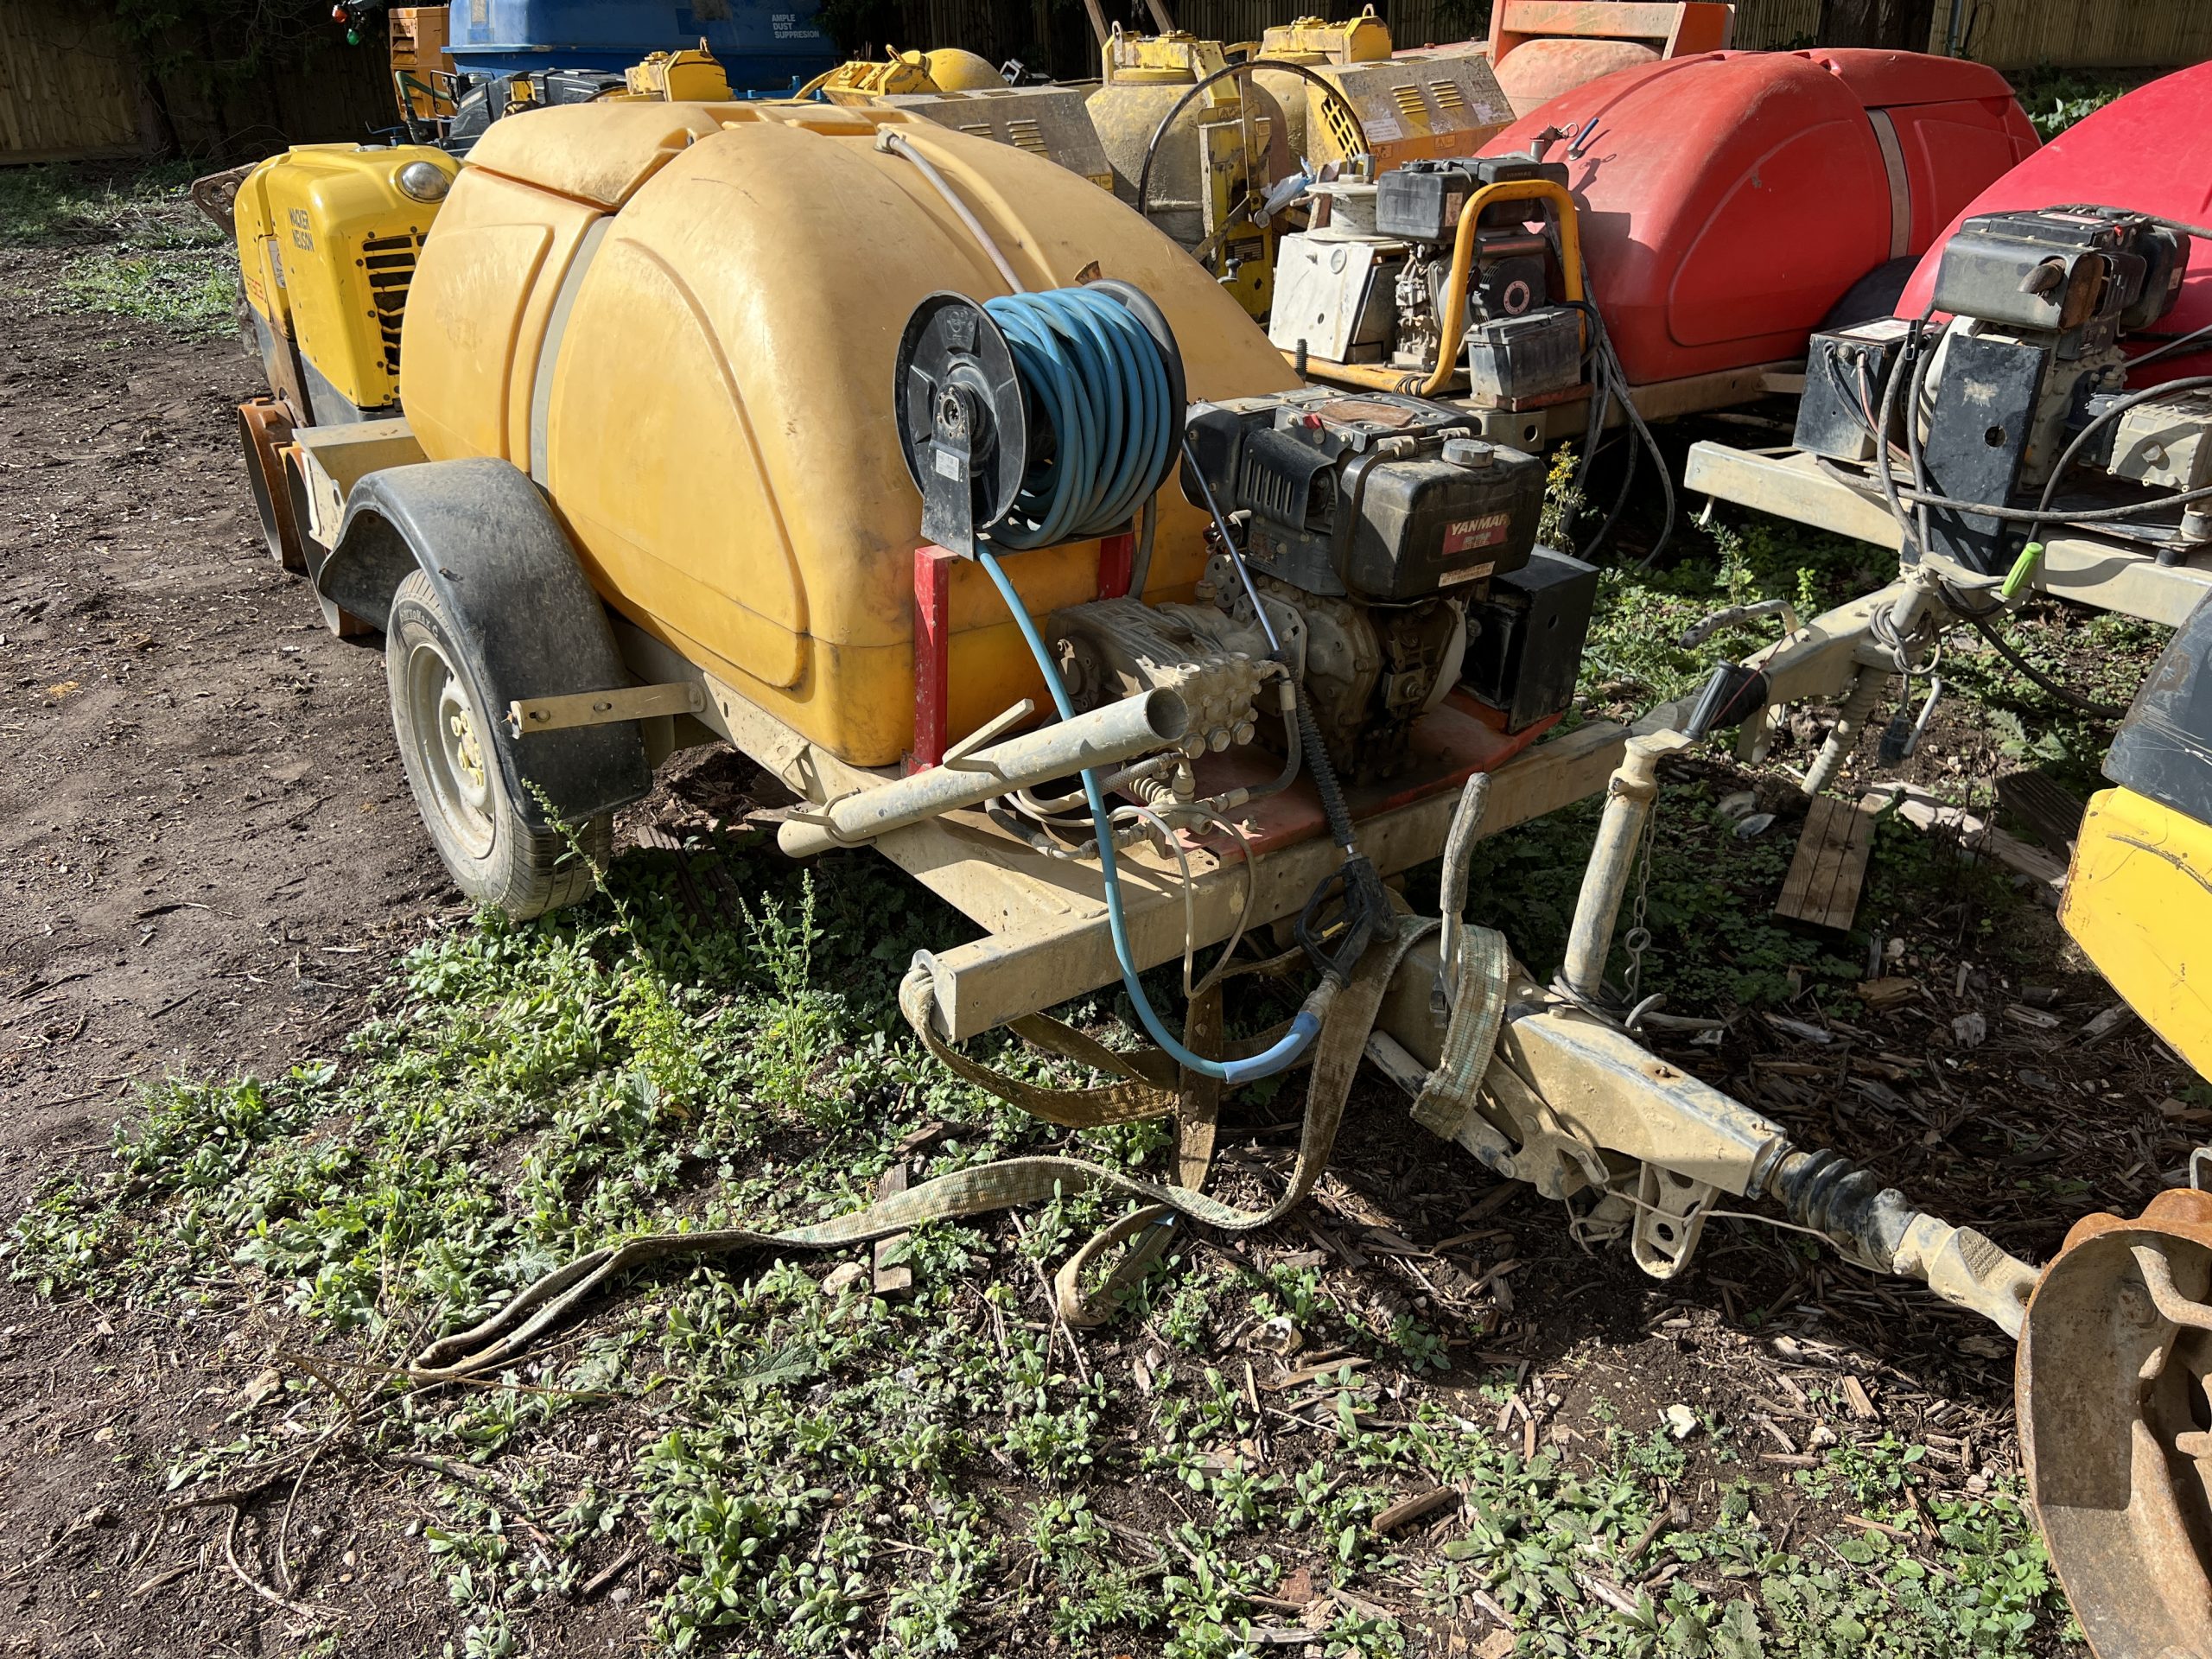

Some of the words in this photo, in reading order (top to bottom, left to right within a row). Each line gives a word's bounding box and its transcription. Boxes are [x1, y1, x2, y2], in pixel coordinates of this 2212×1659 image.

[774, 30, 820, 39] SUPPRESION
[288, 207, 311, 231] WACKER
[291, 229, 315, 252] NEUSON
[1452, 513, 1509, 536] YANMAR
